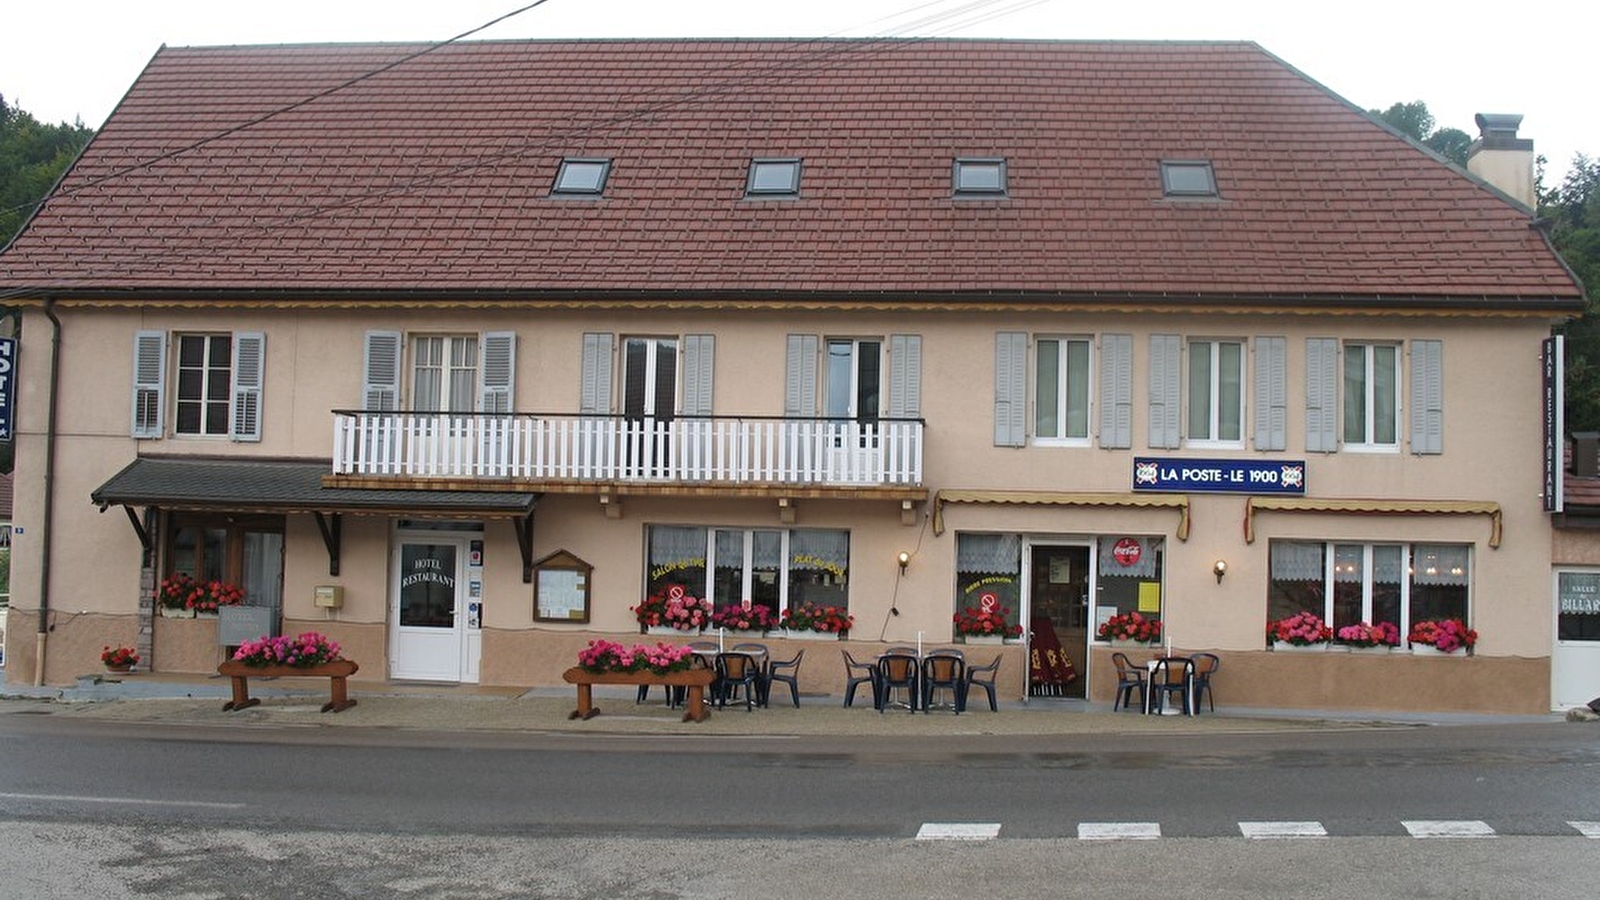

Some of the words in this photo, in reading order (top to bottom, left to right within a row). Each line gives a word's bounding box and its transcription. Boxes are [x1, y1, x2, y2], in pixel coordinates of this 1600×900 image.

[1161, 469, 1178, 481] LA
[1250, 470, 1278, 483] 1900
[414, 559, 442, 570] HOTEL
[652, 561, 677, 580] SALON
[402, 572, 454, 588] RESTAURANT
